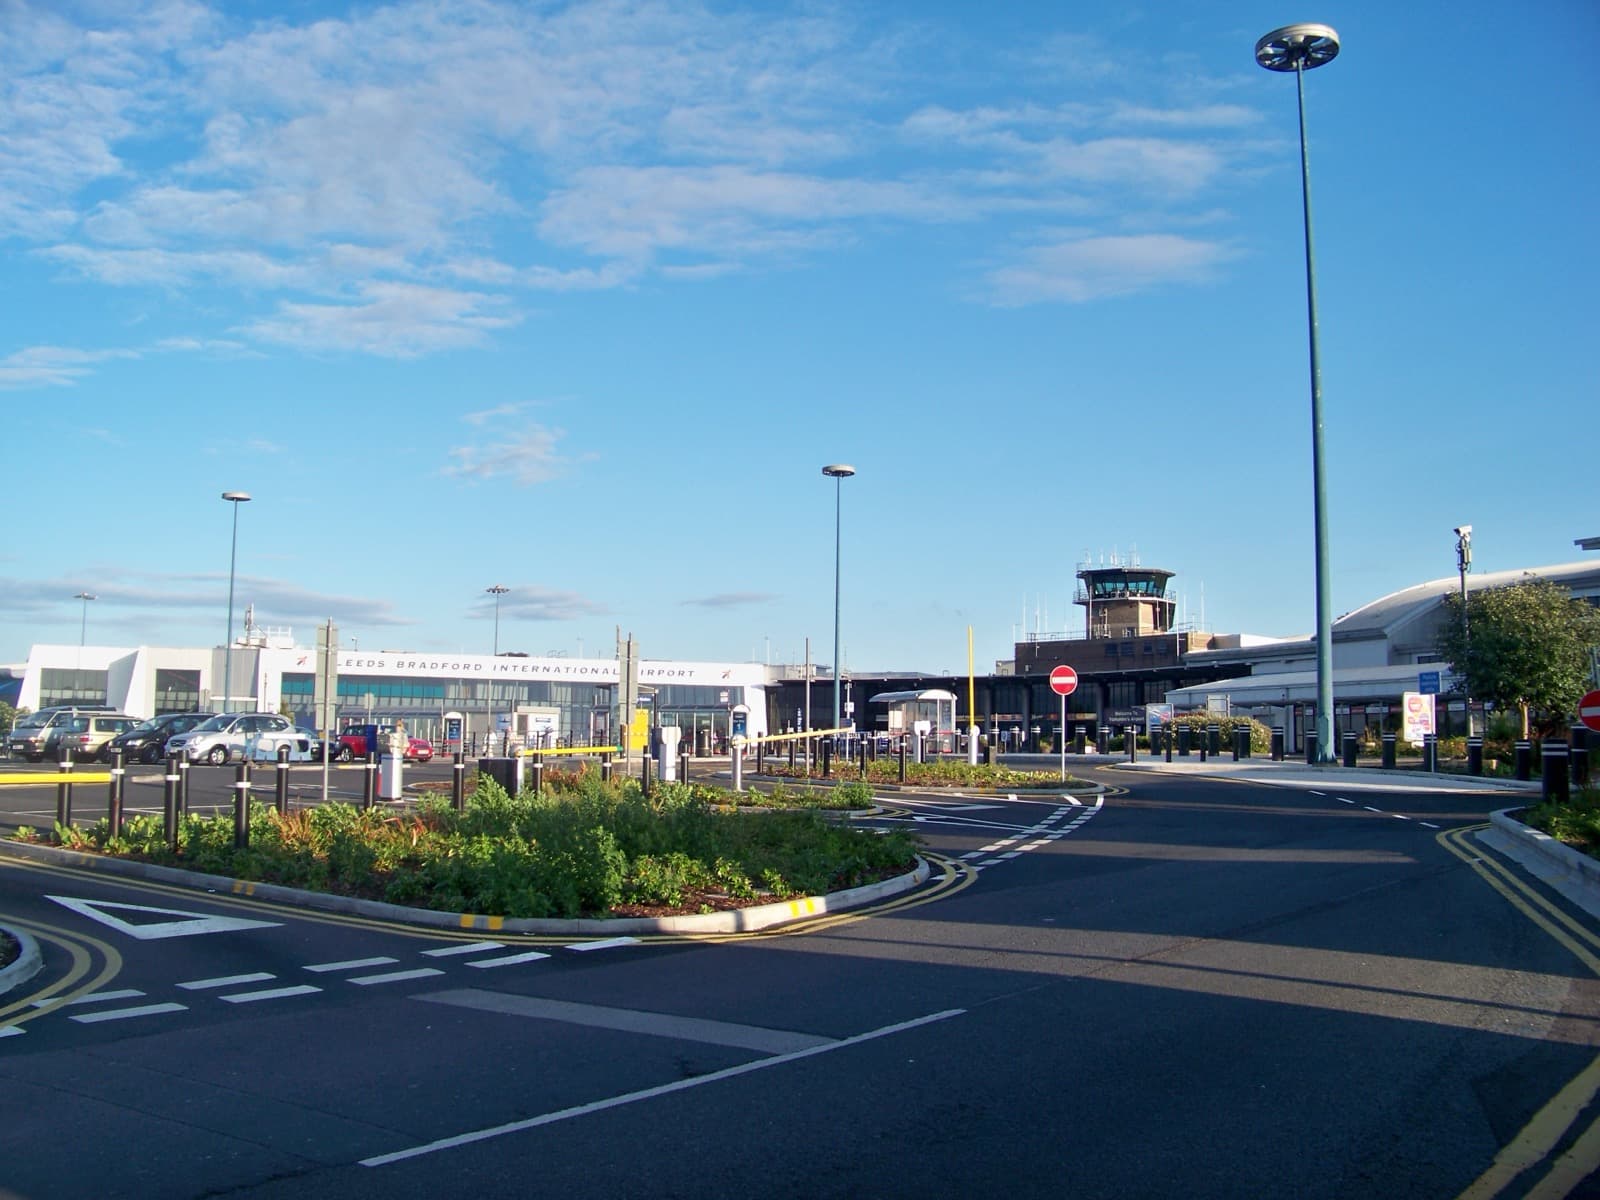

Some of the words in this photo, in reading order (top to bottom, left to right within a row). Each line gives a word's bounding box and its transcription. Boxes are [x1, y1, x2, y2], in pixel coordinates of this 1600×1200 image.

[336, 659, 385, 668] EEDS
[396, 660, 482, 671] BRADFORD
[493, 664, 620, 676] INTERNATIONAL
[640, 667, 695, 677] IRPORT
